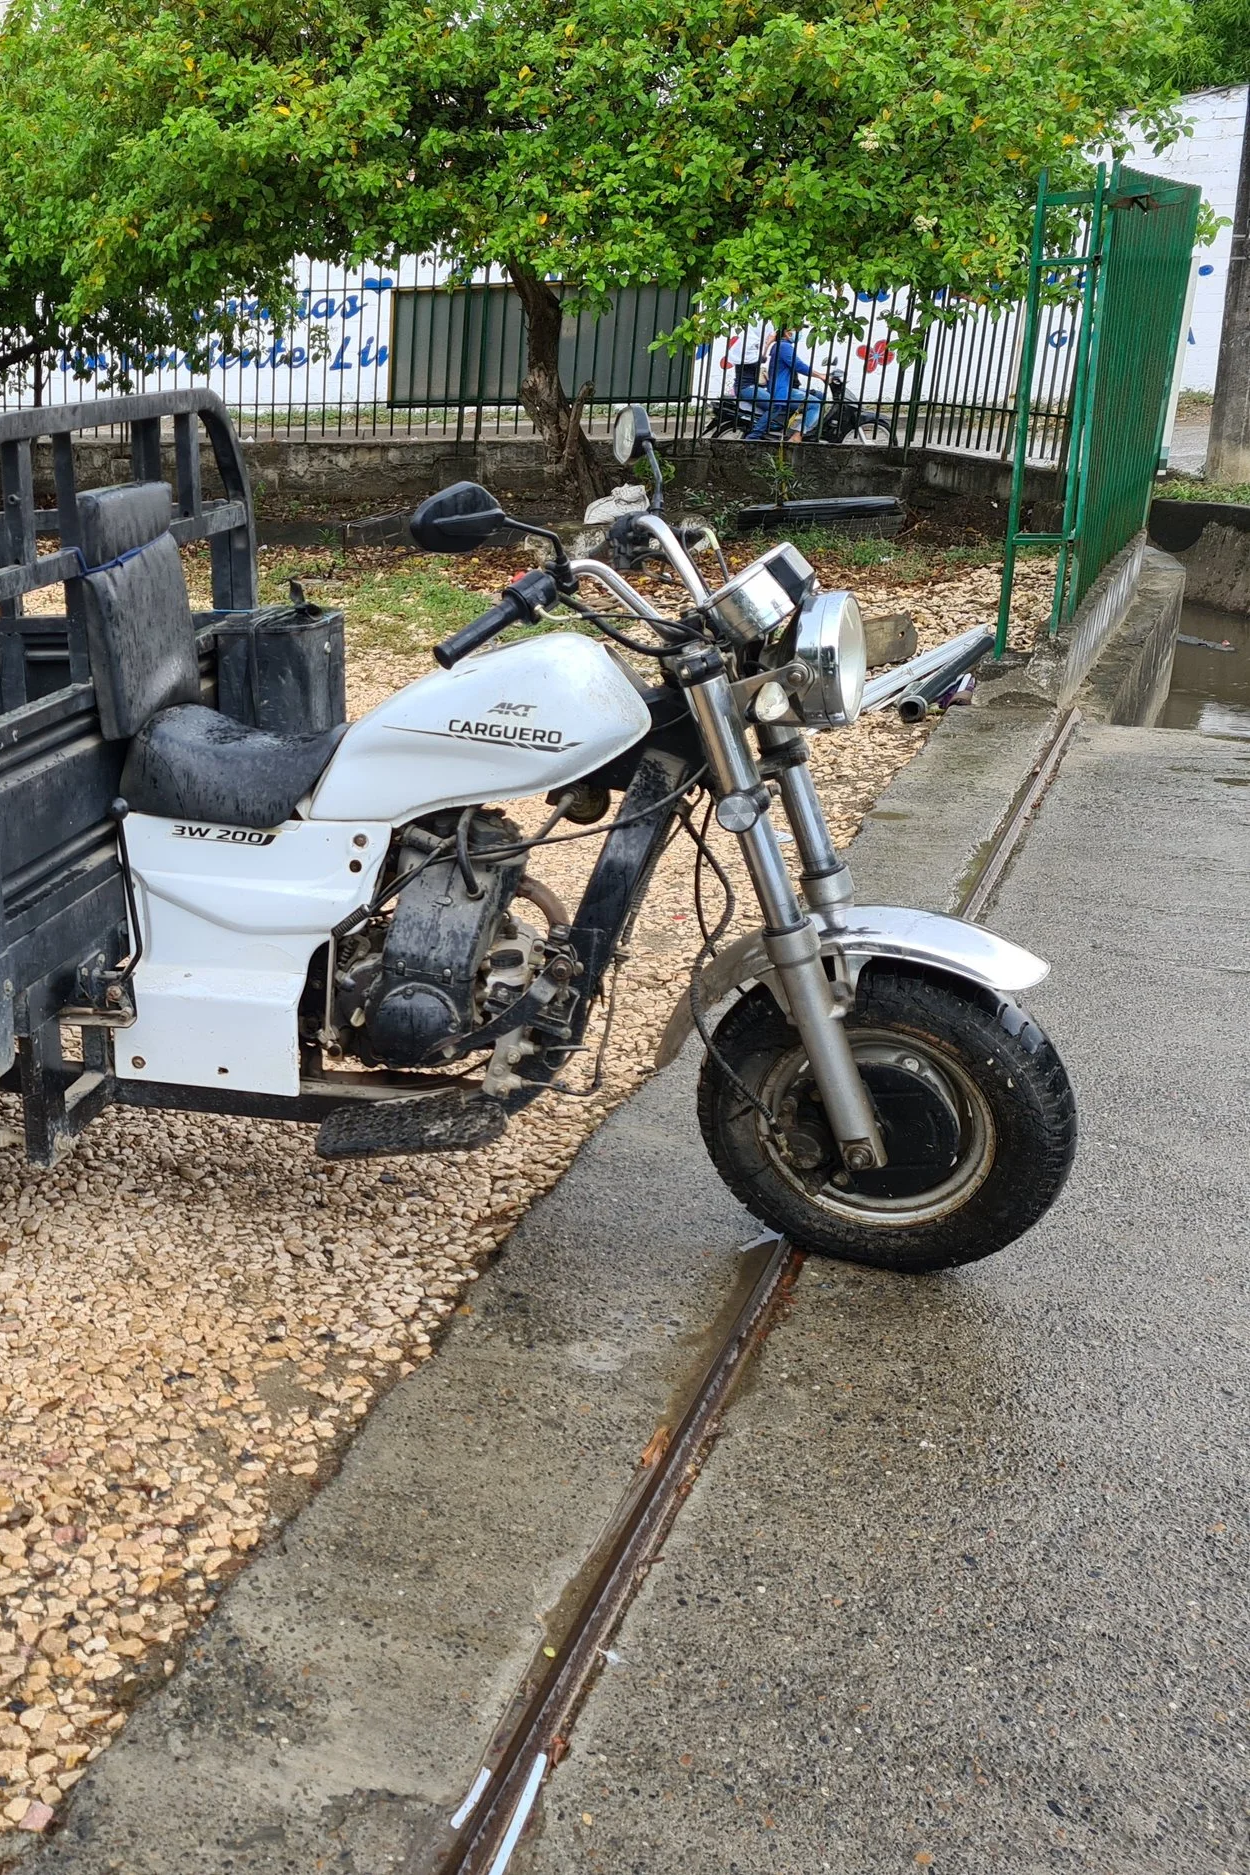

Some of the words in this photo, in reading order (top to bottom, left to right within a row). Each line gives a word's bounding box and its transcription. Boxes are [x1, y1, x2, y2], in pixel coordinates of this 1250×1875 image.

[486, 702, 537, 718] AKT
[448, 719, 562, 744] CARGUERO
[171, 825, 211, 838] 3W
[215, 829, 264, 844] 200
